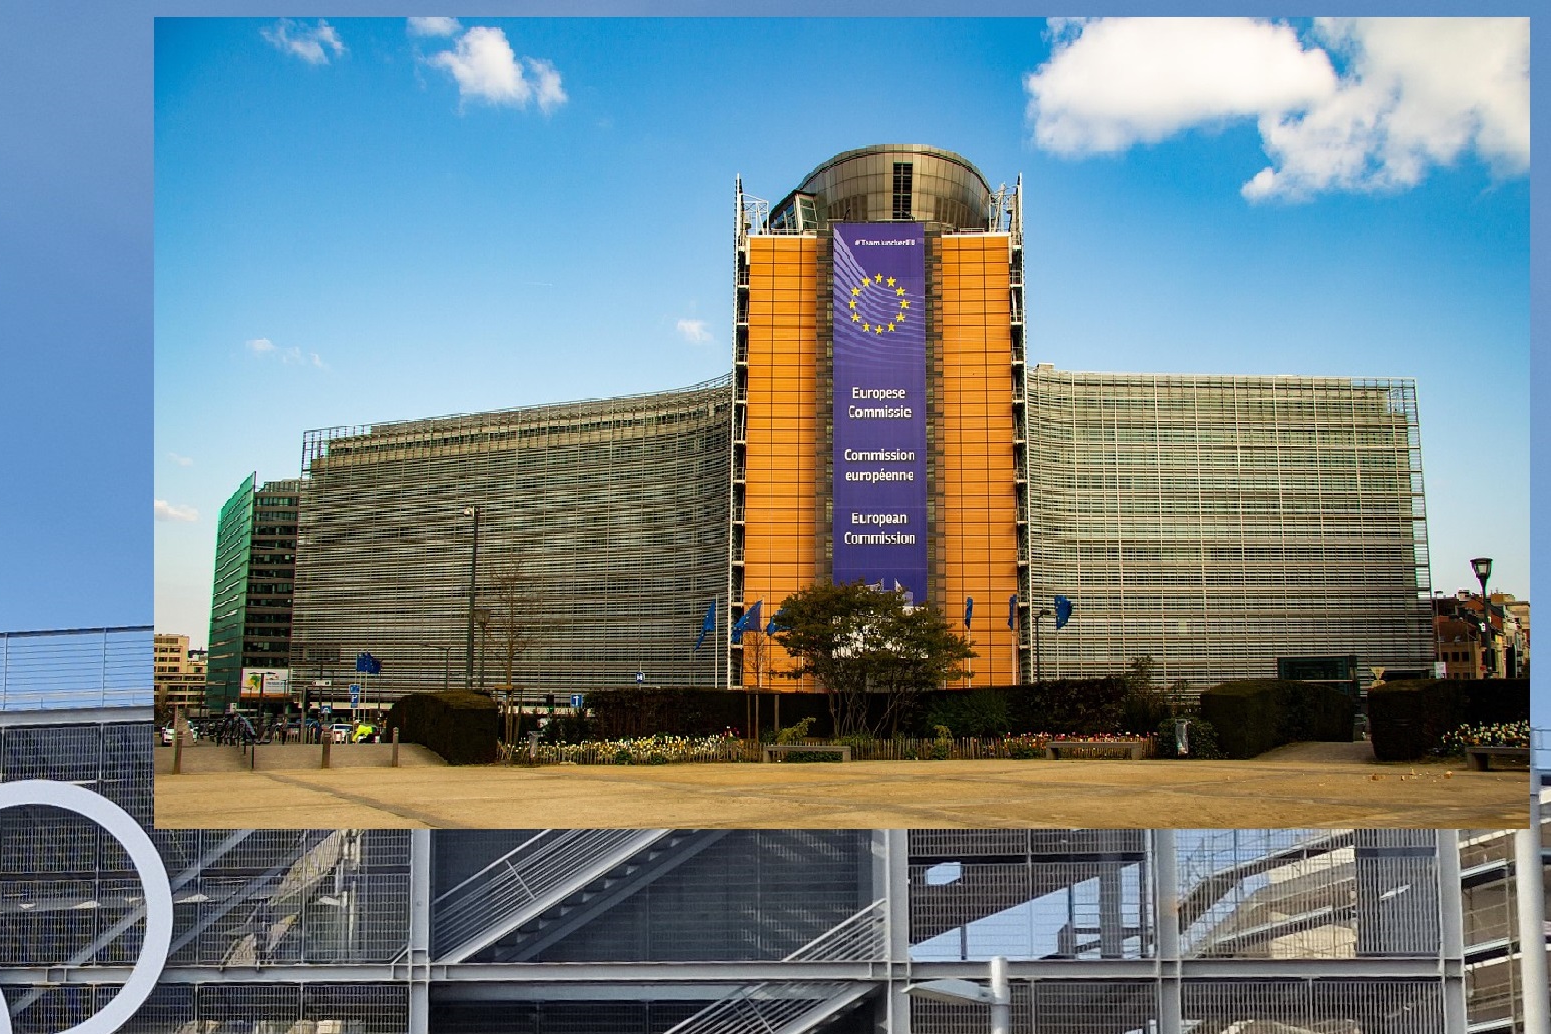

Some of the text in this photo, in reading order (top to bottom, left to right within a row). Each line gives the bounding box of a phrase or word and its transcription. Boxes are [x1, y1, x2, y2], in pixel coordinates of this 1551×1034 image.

[852, 386, 906, 401] Europese
[848, 404, 913, 418] Commissie
[844, 448, 915, 461] Commission
[845, 467, 914, 483] européenne
[851, 512, 907, 527] European
[844, 531, 916, 545] Commission
